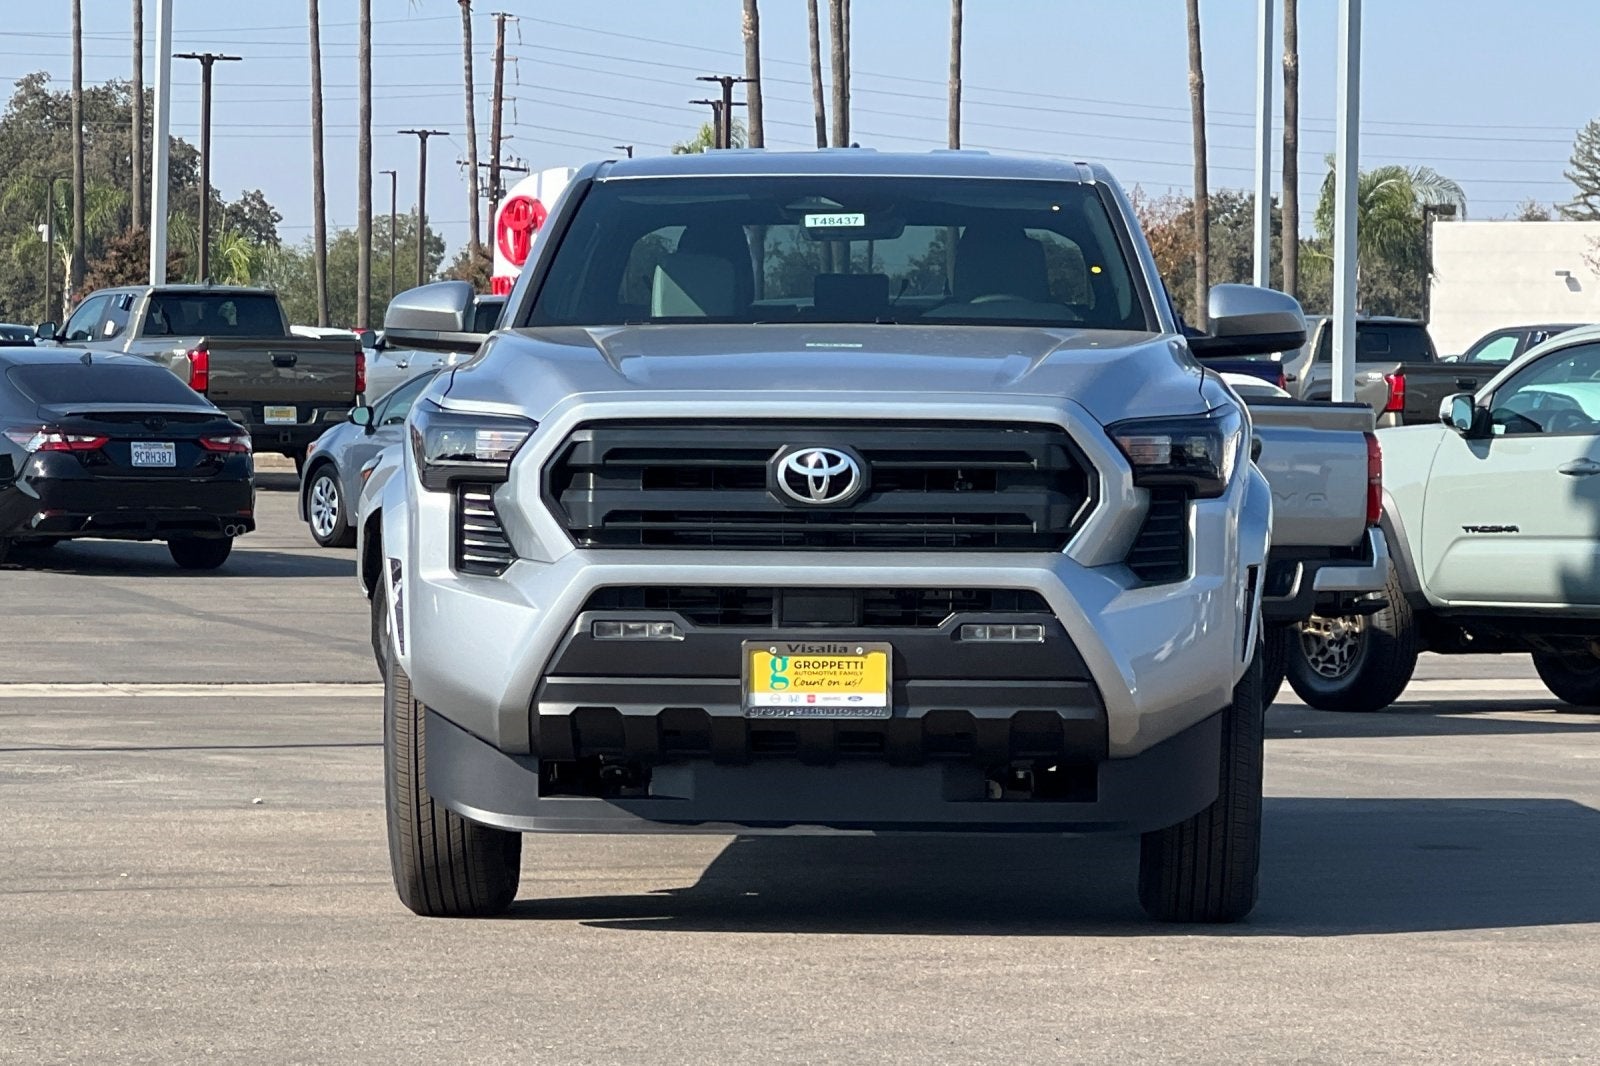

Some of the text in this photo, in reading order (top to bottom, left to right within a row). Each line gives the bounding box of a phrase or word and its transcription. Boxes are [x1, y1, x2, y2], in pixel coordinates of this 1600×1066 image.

[811, 216, 859, 225] T48437
[134, 451, 172, 463] 9CRH387
[1461, 525, 1520, 533] TACOMA
[787, 644, 849, 654] Visalia
[794, 660, 864, 670] GROPPETTI
[793, 677, 826, 687] Count
[844, 677, 863, 687] us!
